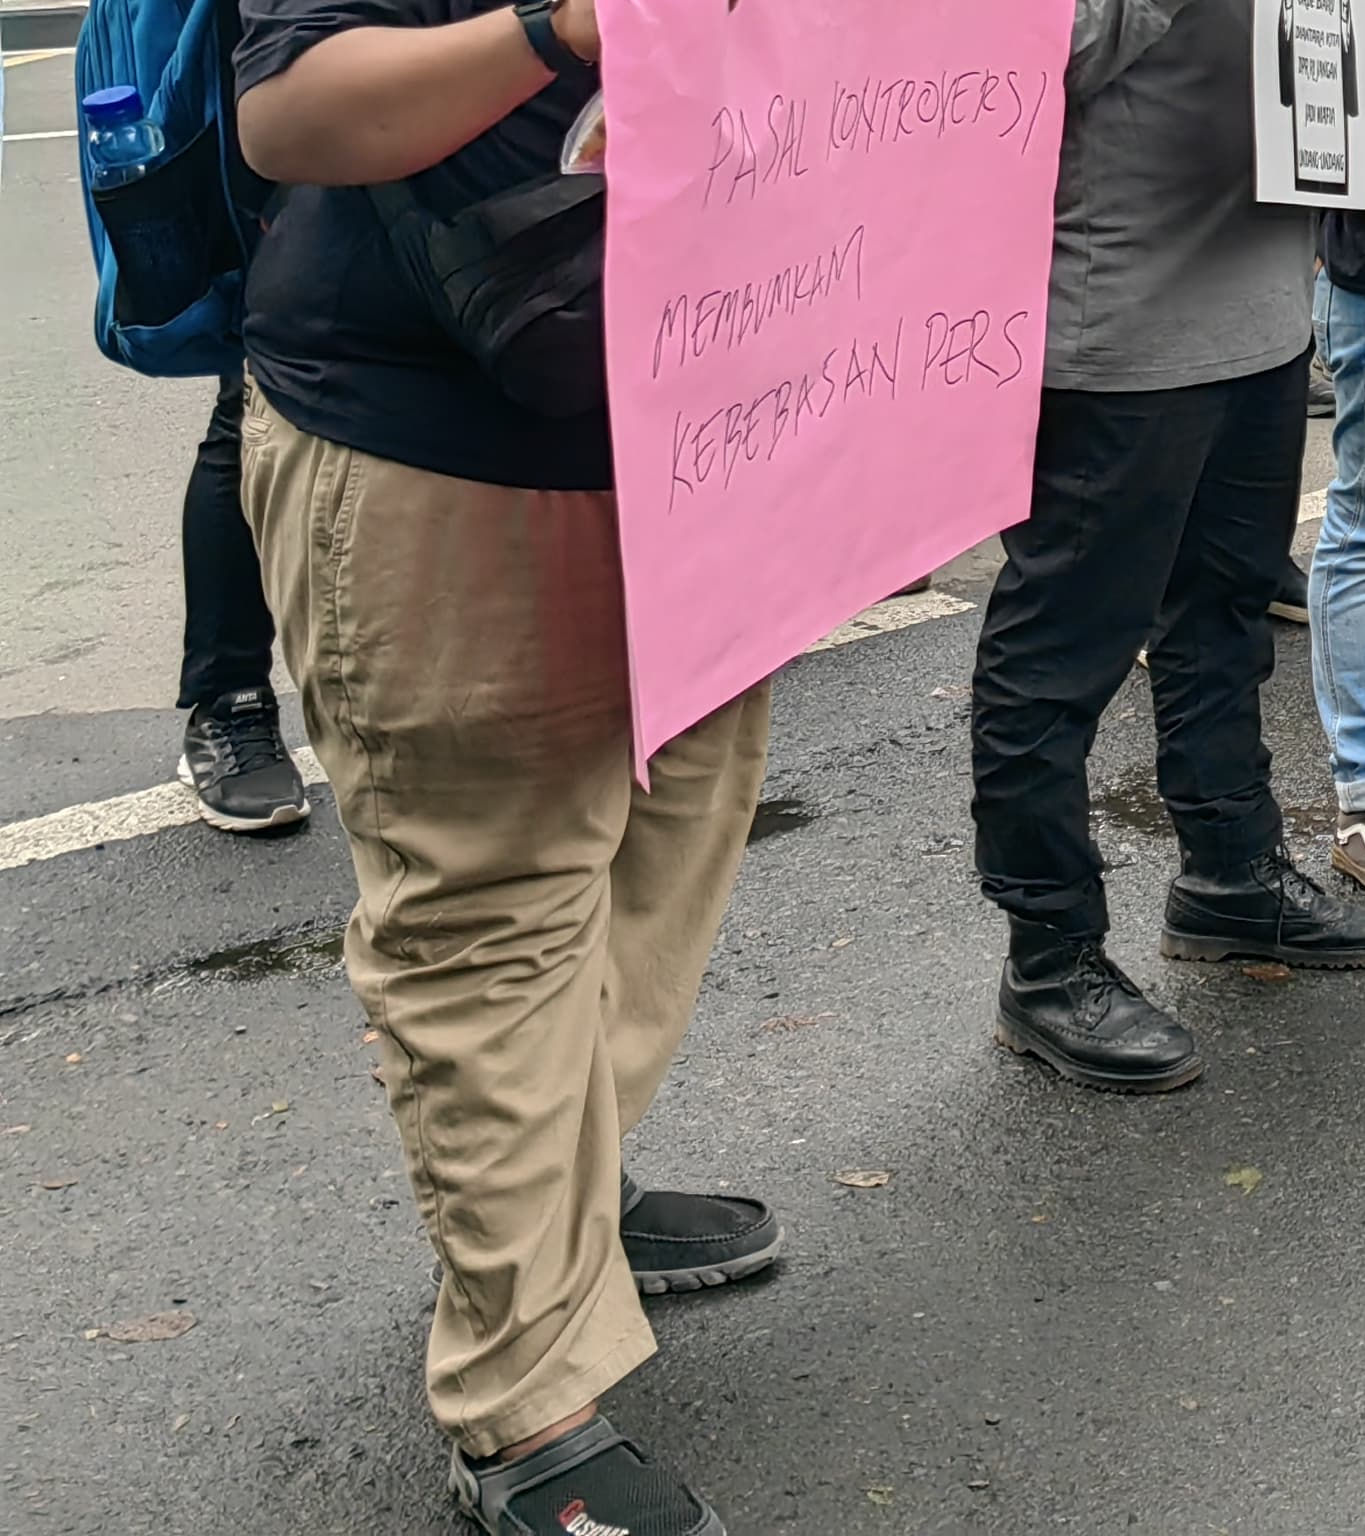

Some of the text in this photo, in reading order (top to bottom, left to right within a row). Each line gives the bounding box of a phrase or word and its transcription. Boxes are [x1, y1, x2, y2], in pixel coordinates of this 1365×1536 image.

[702, 94, 809, 208] PASAL
[669, 310, 1029, 514] KEBEBASAN PERS
